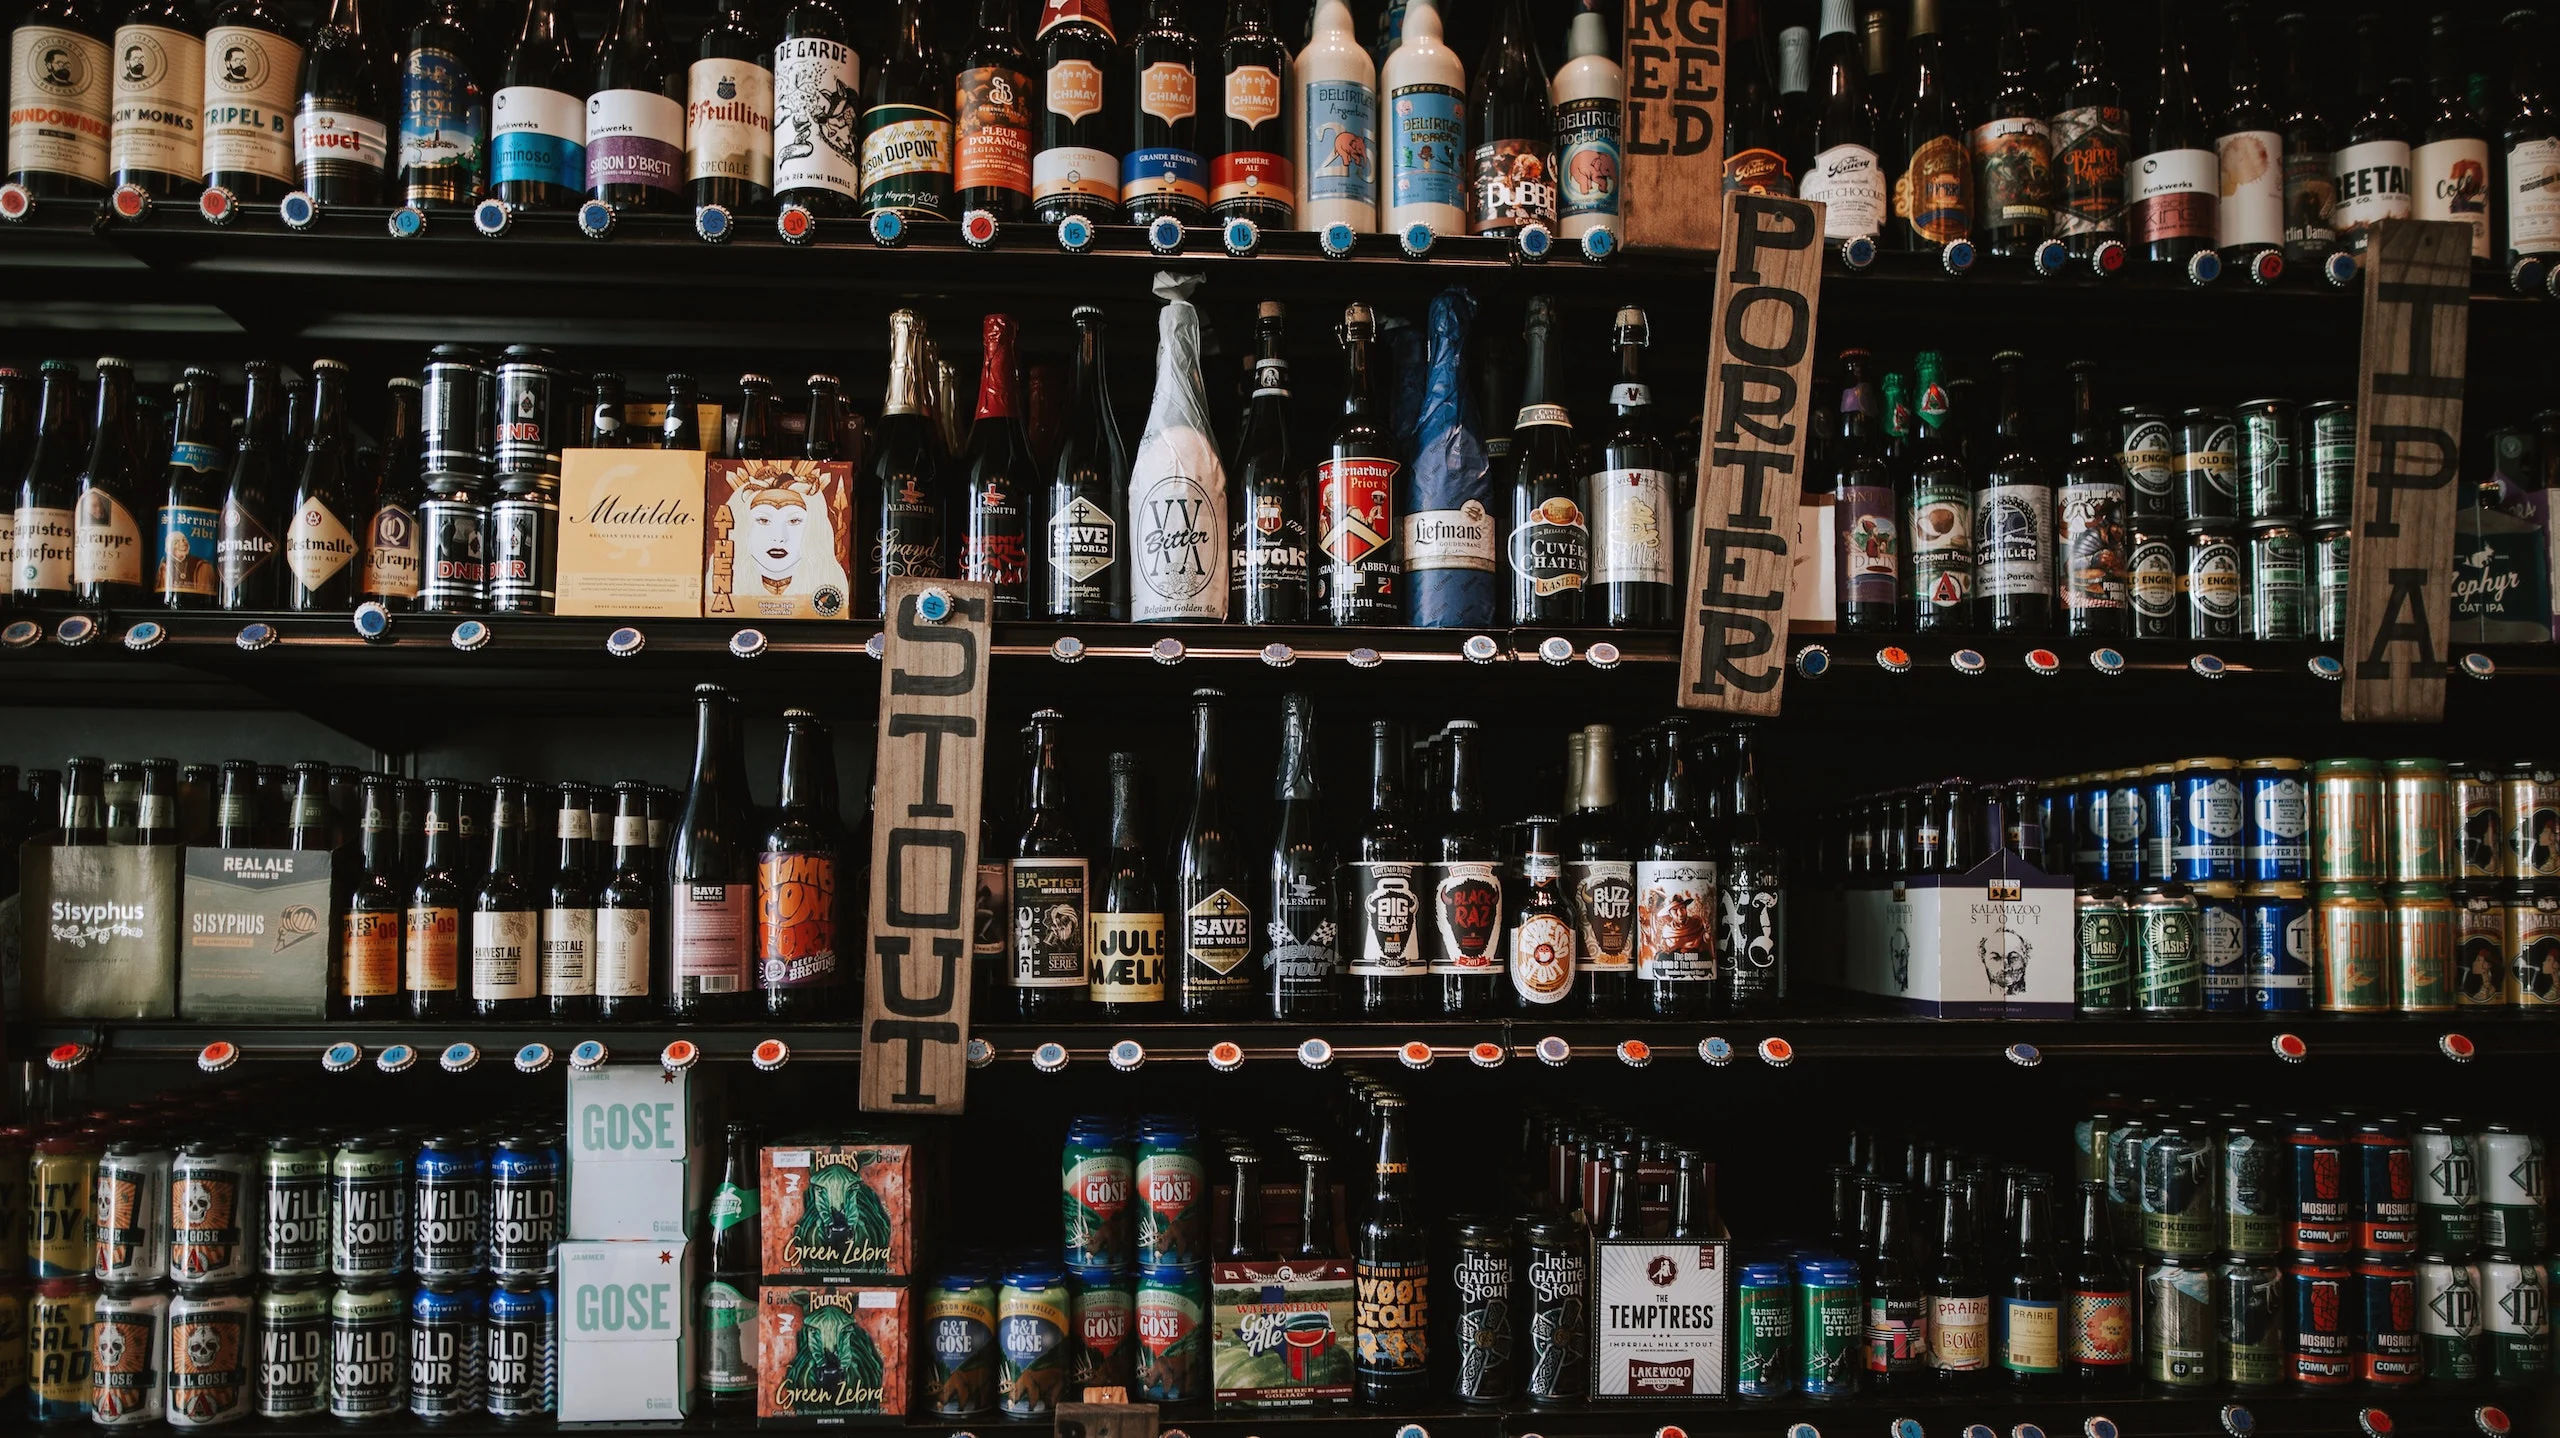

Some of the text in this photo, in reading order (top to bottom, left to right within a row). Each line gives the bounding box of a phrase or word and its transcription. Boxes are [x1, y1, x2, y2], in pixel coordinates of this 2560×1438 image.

[779, 40, 848, 64] DE GARDE
[1053, 89, 1097, 100] CHIMAY
[1148, 92, 1191, 105] CHIMAY
[1232, 95, 1275, 106] CHIMAY
[1329, 103, 1369, 120] Argentum
[139, 108, 194, 130] MONKS
[205, 108, 284, 132] TRIPEL B
[982, 126, 1017, 139] FLEUR
[885, 138, 938, 162] DUPONT
[969, 138, 1028, 152] D'ORANGER
[590, 154, 672, 176] SAISON D'BRETT
[1139, 154, 1168, 163] GRANDE
[1163, 161, 1177, 169] ALE
[700, 161, 750, 176] SPECIALE
[806, 173, 850, 189] WINE BARRELS
[2143, 182, 2193, 194] funkwerks
[918, 193, 939, 208] 2015
[1069, 227, 1080, 239] 15
[1237, 227, 1249, 242] 16
[1414, 231, 1426, 243] 17
[1691, 195, 1816, 697] PORTER
[2119, 454, 2139, 466] OLD
[2198, 455, 2220, 466] OLD
[1351, 477, 1387, 489] Prior 8
[2356, 281, 2470, 680] IPA
[1054, 527, 1108, 544] SAVE
[1413, 518, 1482, 547] Liefmans
[871, 528, 941, 562] Grand
[1072, 545, 1108, 553] WORLD
[1145, 530, 1209, 554] Bitter
[711, 504, 735, 613] ATHENA
[1913, 552, 1950, 564] COCONUT
[437, 559, 486, 582] DNR
[1360, 562, 1389, 572] ABBEY
[1541, 575, 1580, 593] KASTEEL
[2451, 566, 2520, 603] Zephyr
[1144, 606, 1171, 614] Belgian
[1174, 603, 1202, 612] Golden
[2459, 603, 2504, 613] OAT IPA
[869, 591, 986, 1105] STOUT
[2200, 847, 2225, 857] LATER
[2266, 847, 2290, 857] LATER
[223, 856, 294, 873] REAL ALE
[237, 871, 270, 880] BREWING
[1017, 878, 1081, 888] BAPTIST
[692, 887, 723, 896] SAVE
[1593, 887, 1630, 902] BUZZ
[51, 902, 144, 926] Sisyphus
[1378, 897, 1409, 917] BIG
[1593, 901, 1630, 919] NUTZ
[1971, 904, 2041, 914] KALAMAZOO
[1378, 916, 1408, 925] BLACK
[1455, 906, 1490, 928] RAZ
[1971, 914, 2041, 925] STOUT
[192, 913, 265, 936] SISYPHUS
[1194, 918, 1247, 935] SAVE
[1377, 925, 1408, 933] COWBELL
[543, 940, 584, 951] HARVEST ALE
[1217, 937, 1247, 945] WORLD
[2090, 941, 2117, 954] OASIS
[2158, 940, 2185, 953] OASIS
[474, 946, 522, 959] HARVEST ALE
[789, 955, 836, 982] BREWING
[792, 956, 813, 969] DEEP
[1049, 960, 1078, 969] SERIES
[1277, 962, 1331, 976] STOUT
[1385, 959, 1399, 967] 2016
[1465, 958, 1480, 966] 2017
[2220, 976, 2239, 986] DAYS
[2168, 986, 2180, 995] IPA
[1045, 1049, 1055, 1058] 14
[581, 1102, 675, 1152] GOSE
[876, 1150, 883, 1164] 6
[1085, 1182, 1128, 1203] GOSE
[1149, 1181, 1193, 1202] GOSE
[2301, 1202, 2337, 1215] MOSAIC
[2377, 1202, 2410, 1215] MOSAIC
[2440, 1214, 2458, 1222] INDIA
[189, 1230, 219, 1243] GOSE
[344, 1219, 406, 1244] SOUR
[418, 1221, 478, 1244] SOUR
[494, 1221, 553, 1244] SOUR
[2299, 1229, 2349, 1243] COMMUNITY
[783, 1235, 892, 1267] Green Zebra
[811, 1266, 884, 1274] Brewed with Watermelon and Sea
[767, 1290, 773, 1305] 6
[1656, 1294, 1668, 1303] THE
[1887, 1300, 1919, 1309] PRAIRIE
[575, 1283, 671, 1332] GOSE
[1235, 1303, 1328, 1314] WATERMELON
[1938, 1302, 1988, 1316] PRAIRIE
[2511, 1288, 2548, 1326] IPA
[1609, 1304, 1714, 1329] TEMPTRESS
[2013, 1308, 2054, 1322] PRAIRIE
[939, 1319, 968, 1337] G&T
[1010, 1318, 1039, 1337] G&T
[1083, 1317, 1125, 1338] GOSE
[1139, 1316, 1179, 1338] GOSE
[1240, 1312, 1287, 1340] Gose
[935, 1335, 972, 1353] GOSE
[1006, 1334, 1042, 1353] GOSE
[1249, 1330, 1283, 1357] Ale
[2300, 1334, 2335, 1348] MOSAIC
[2378, 1334, 2410, 1347] MOSAIC
[2510, 1343, 2527, 1351] INDIA
[260, 1362, 319, 1386] SOUR
[335, 1362, 395, 1386] SOUR
[1631, 1366, 1691, 1378] LAKEWOOD
[2298, 1361, 2349, 1376] COMMUNITY
[197, 1372, 228, 1385] GOSE
[775, 1377, 885, 1409] Green Zebra
